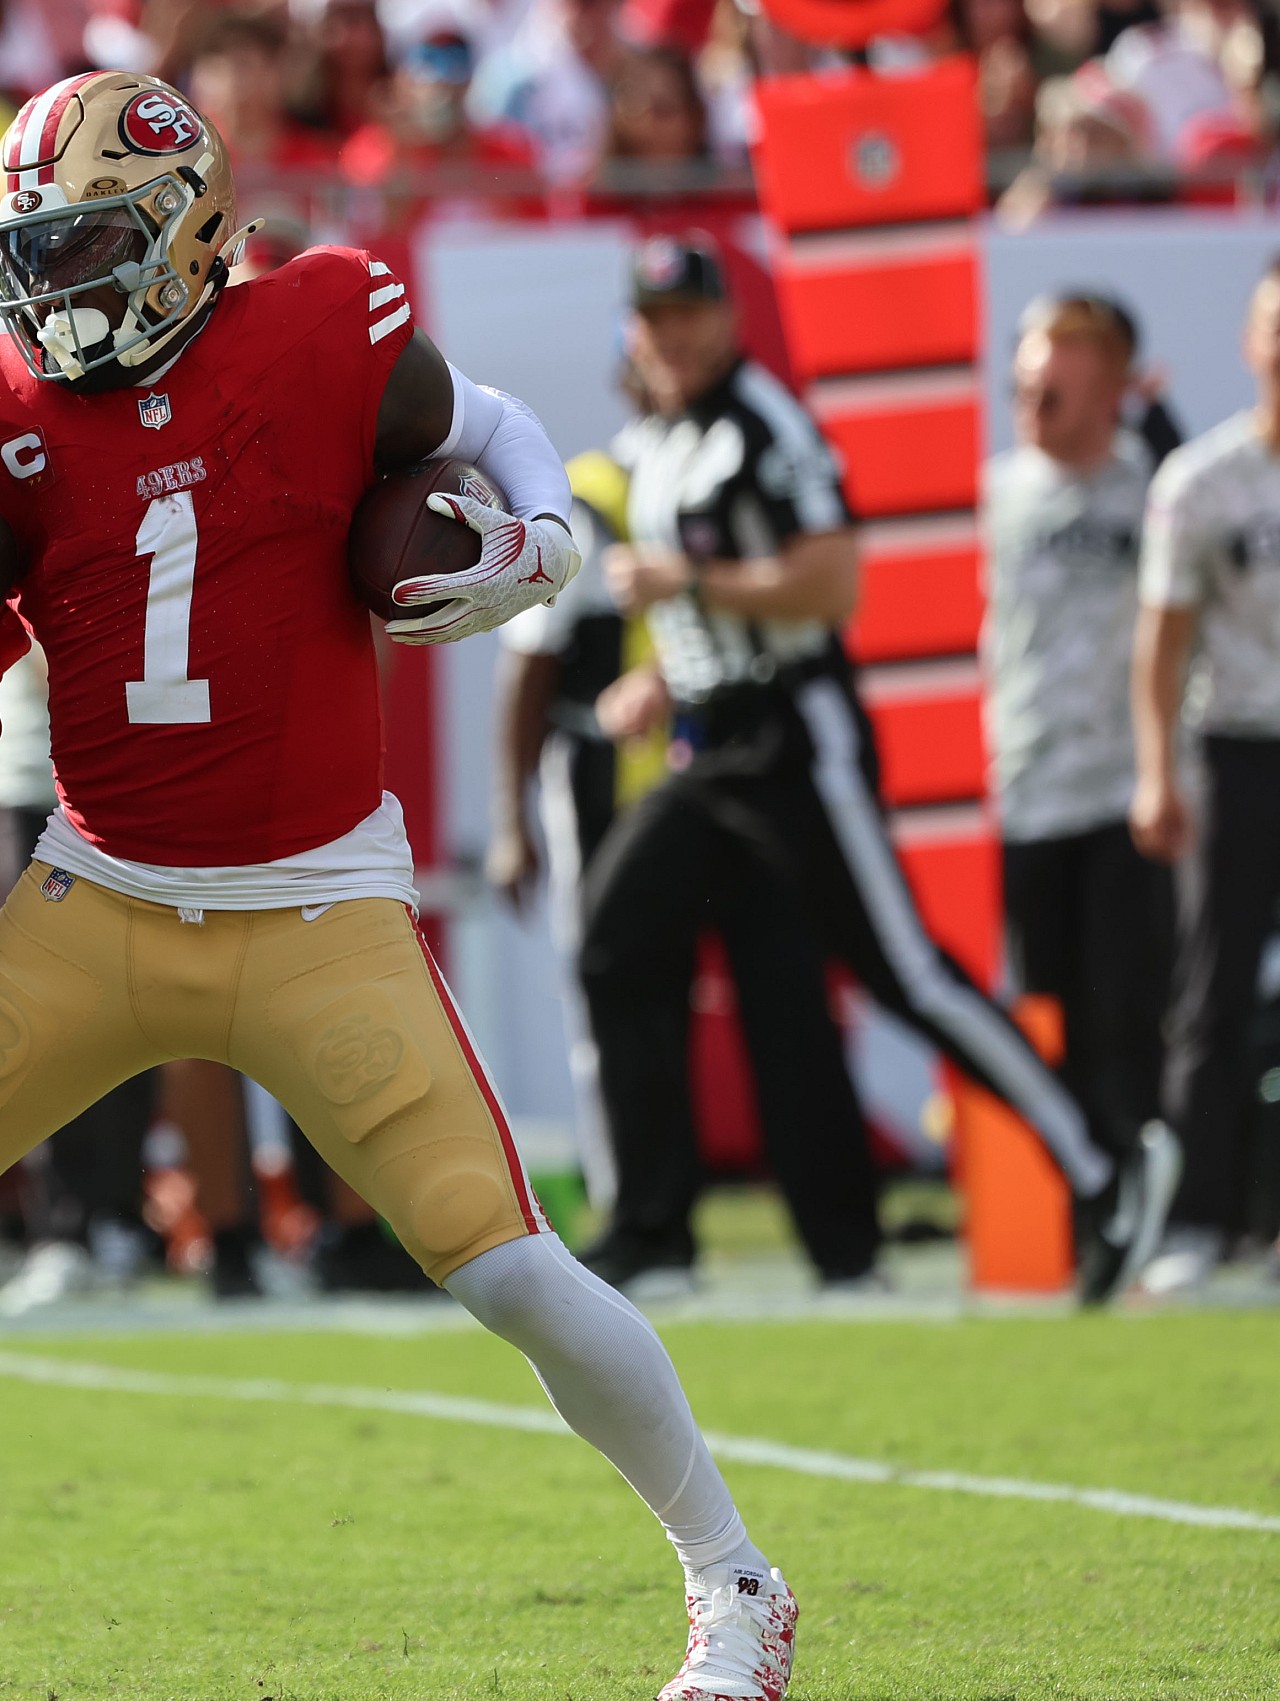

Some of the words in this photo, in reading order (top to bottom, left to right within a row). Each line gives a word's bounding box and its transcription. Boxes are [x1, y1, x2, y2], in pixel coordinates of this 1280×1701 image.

[86, 188, 125, 197] OAKLEY
[144, 407, 166, 422] NFL
[0, 432, 46, 479] C
[136, 456, 207, 500] 49ERS
[125, 490, 211, 724] 1
[44, 879, 64, 897] NFL
